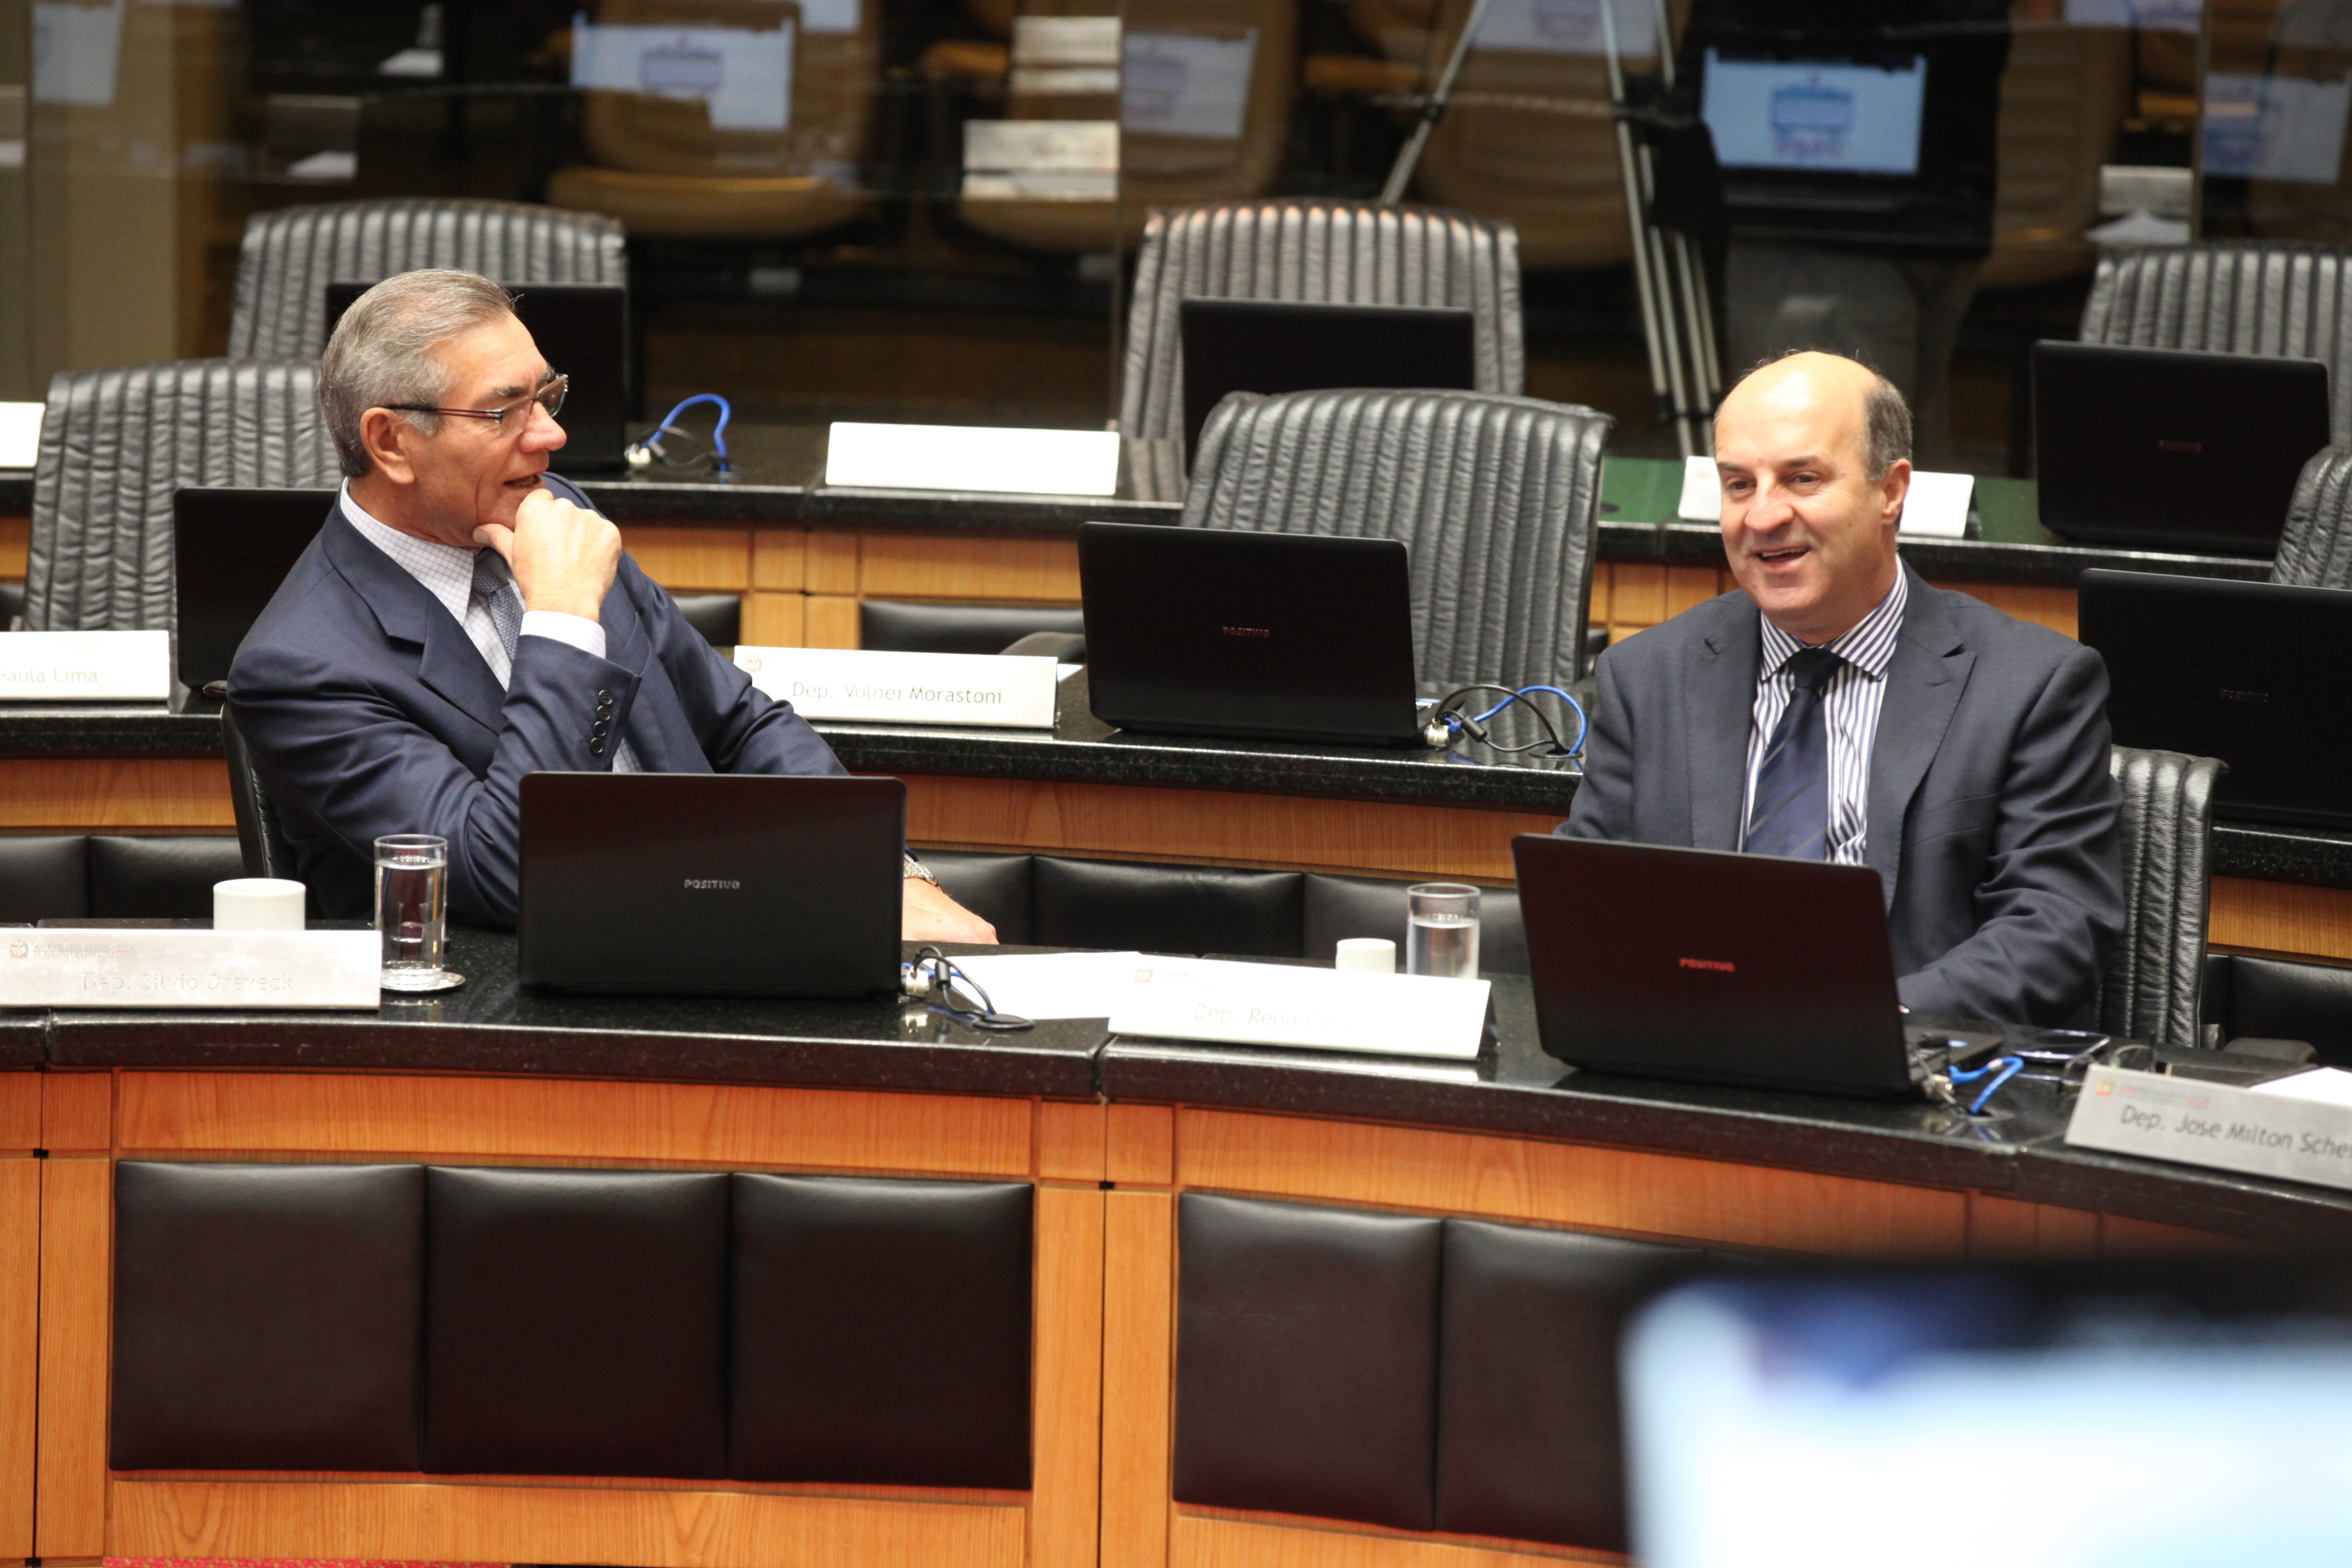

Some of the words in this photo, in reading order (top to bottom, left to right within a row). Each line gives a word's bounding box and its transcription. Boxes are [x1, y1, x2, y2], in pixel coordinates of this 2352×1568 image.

[53, 668, 98, 683] Lima
[792, 682, 833, 701] Dep.
[845, 683, 901, 700] Volnei
[909, 685, 1003, 704] Morastoni
[683, 879, 740, 890] POSITIVO
[83, 973, 131, 994] Dep.
[141, 972, 199, 991] Silvio
[207, 972, 293, 991] Dreveck
[1194, 1002, 1239, 1025] Dep.
[1248, 1007, 1298, 1027] Reno
[2120, 1103, 2166, 1133] Dep.
[2175, 1113, 2222, 1139] Jose
[2224, 1121, 2294, 1150] Milton
